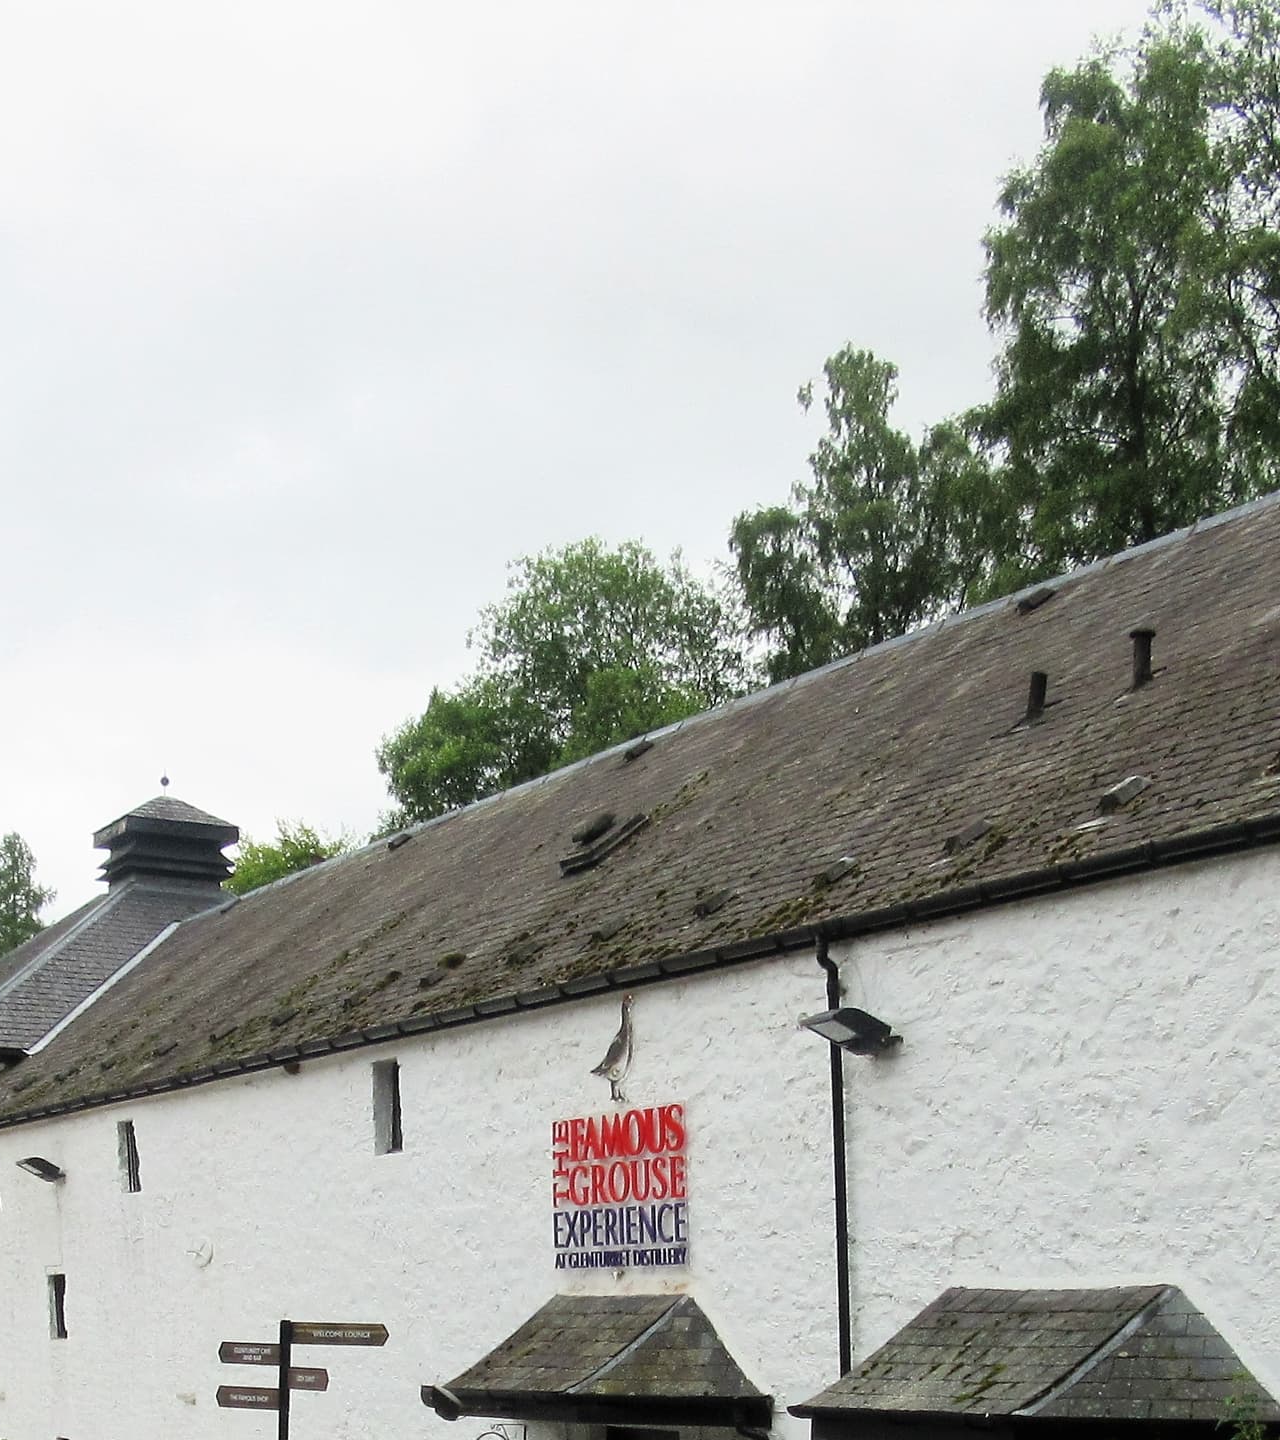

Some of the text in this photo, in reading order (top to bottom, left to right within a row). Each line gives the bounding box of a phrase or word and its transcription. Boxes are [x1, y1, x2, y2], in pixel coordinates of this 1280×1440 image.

[569, 1103, 685, 1162] FAMOUS
[552, 1121, 569, 1207] THE
[570, 1156, 685, 1207] GROUSE
[553, 1203, 687, 1249] EXPERIENCE
[555, 1252, 567, 1269] AT
[633, 1247, 687, 1267] DISTILLERY
